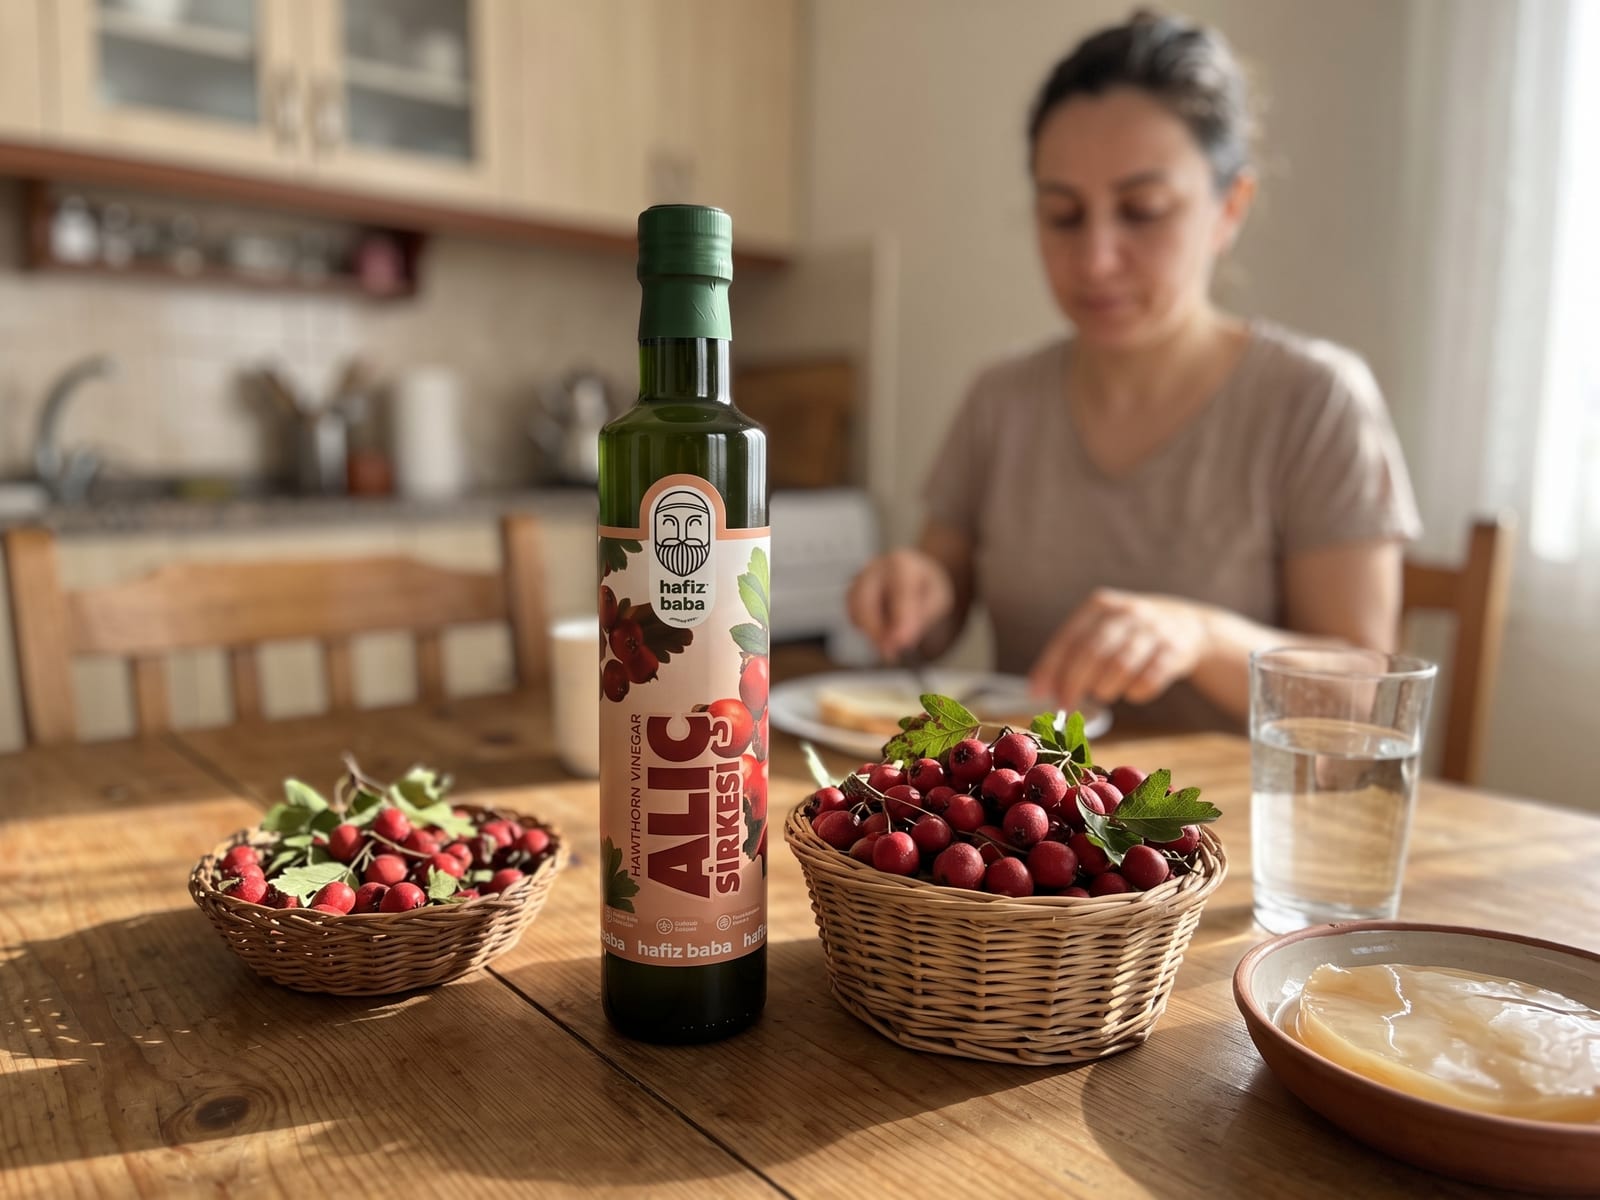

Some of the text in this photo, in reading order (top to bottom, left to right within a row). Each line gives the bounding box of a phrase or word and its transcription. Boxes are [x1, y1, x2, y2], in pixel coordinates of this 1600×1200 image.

[660, 579, 706, 594] hafiz
[660, 596, 705, 611] baba
[630, 713, 642, 877] HAWTHORN VINEGAR
[637, 939, 733, 959] hafiz baba
